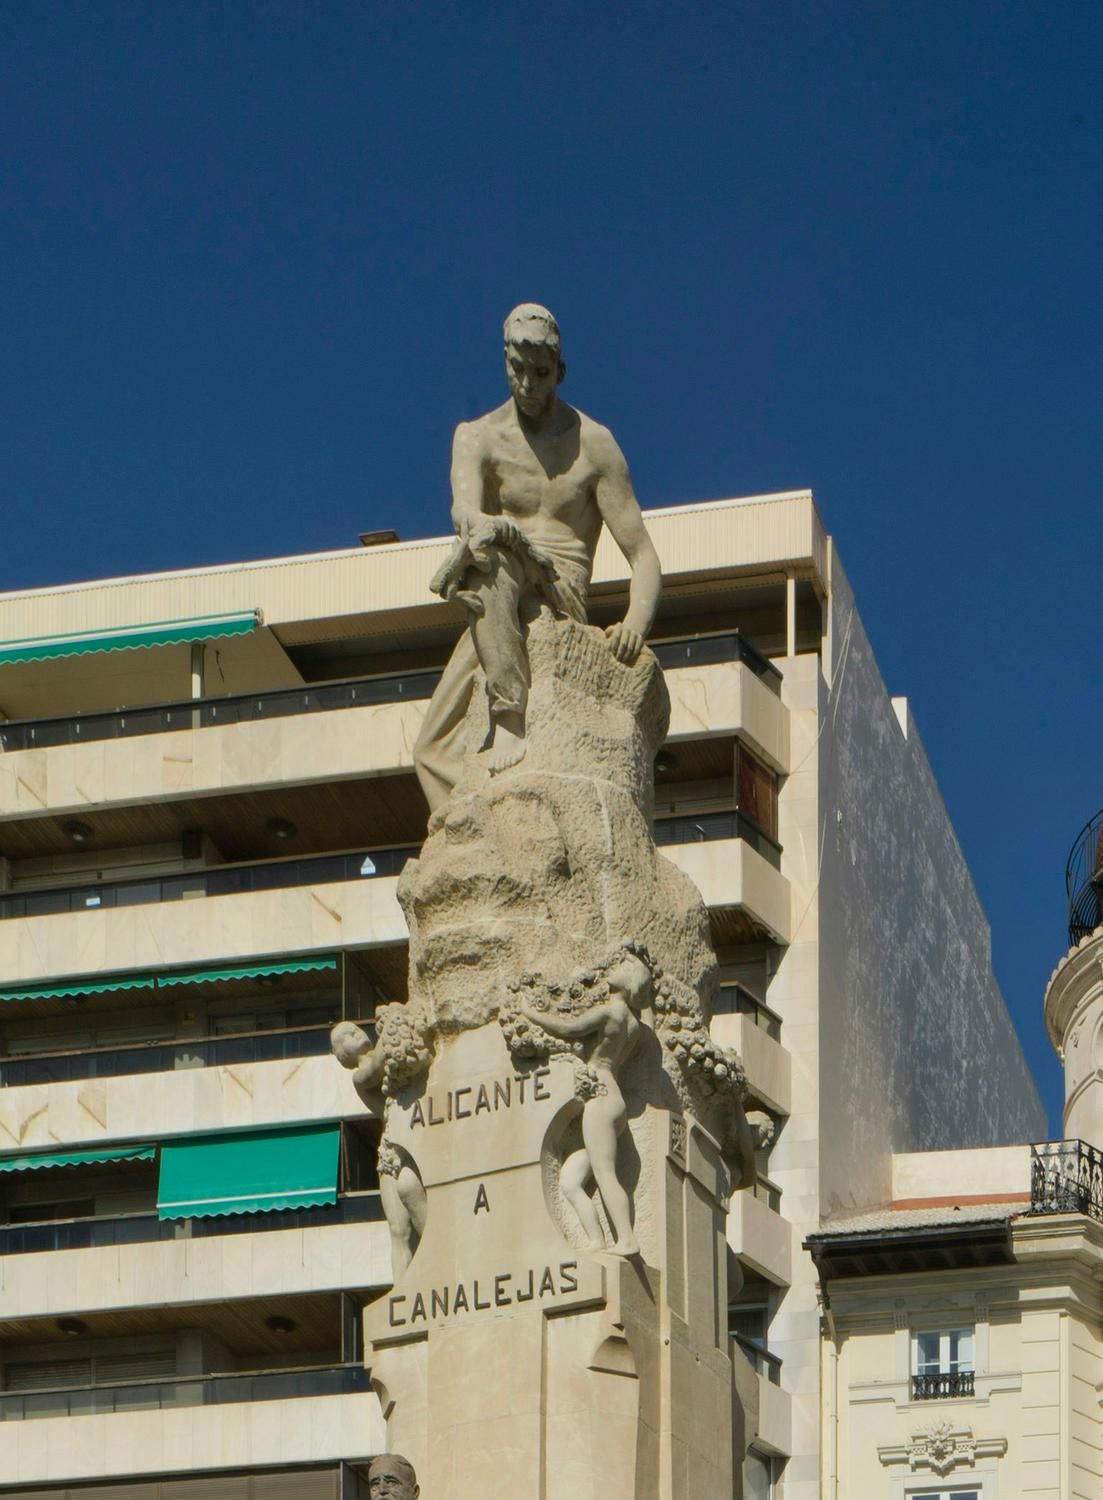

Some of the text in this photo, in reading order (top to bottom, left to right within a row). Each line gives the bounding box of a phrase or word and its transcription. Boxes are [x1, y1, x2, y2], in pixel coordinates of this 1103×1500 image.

[409, 1068, 551, 1130] ALICANTE
[473, 1183, 490, 1215] A
[388, 1261, 578, 1327] CANALEJAS
